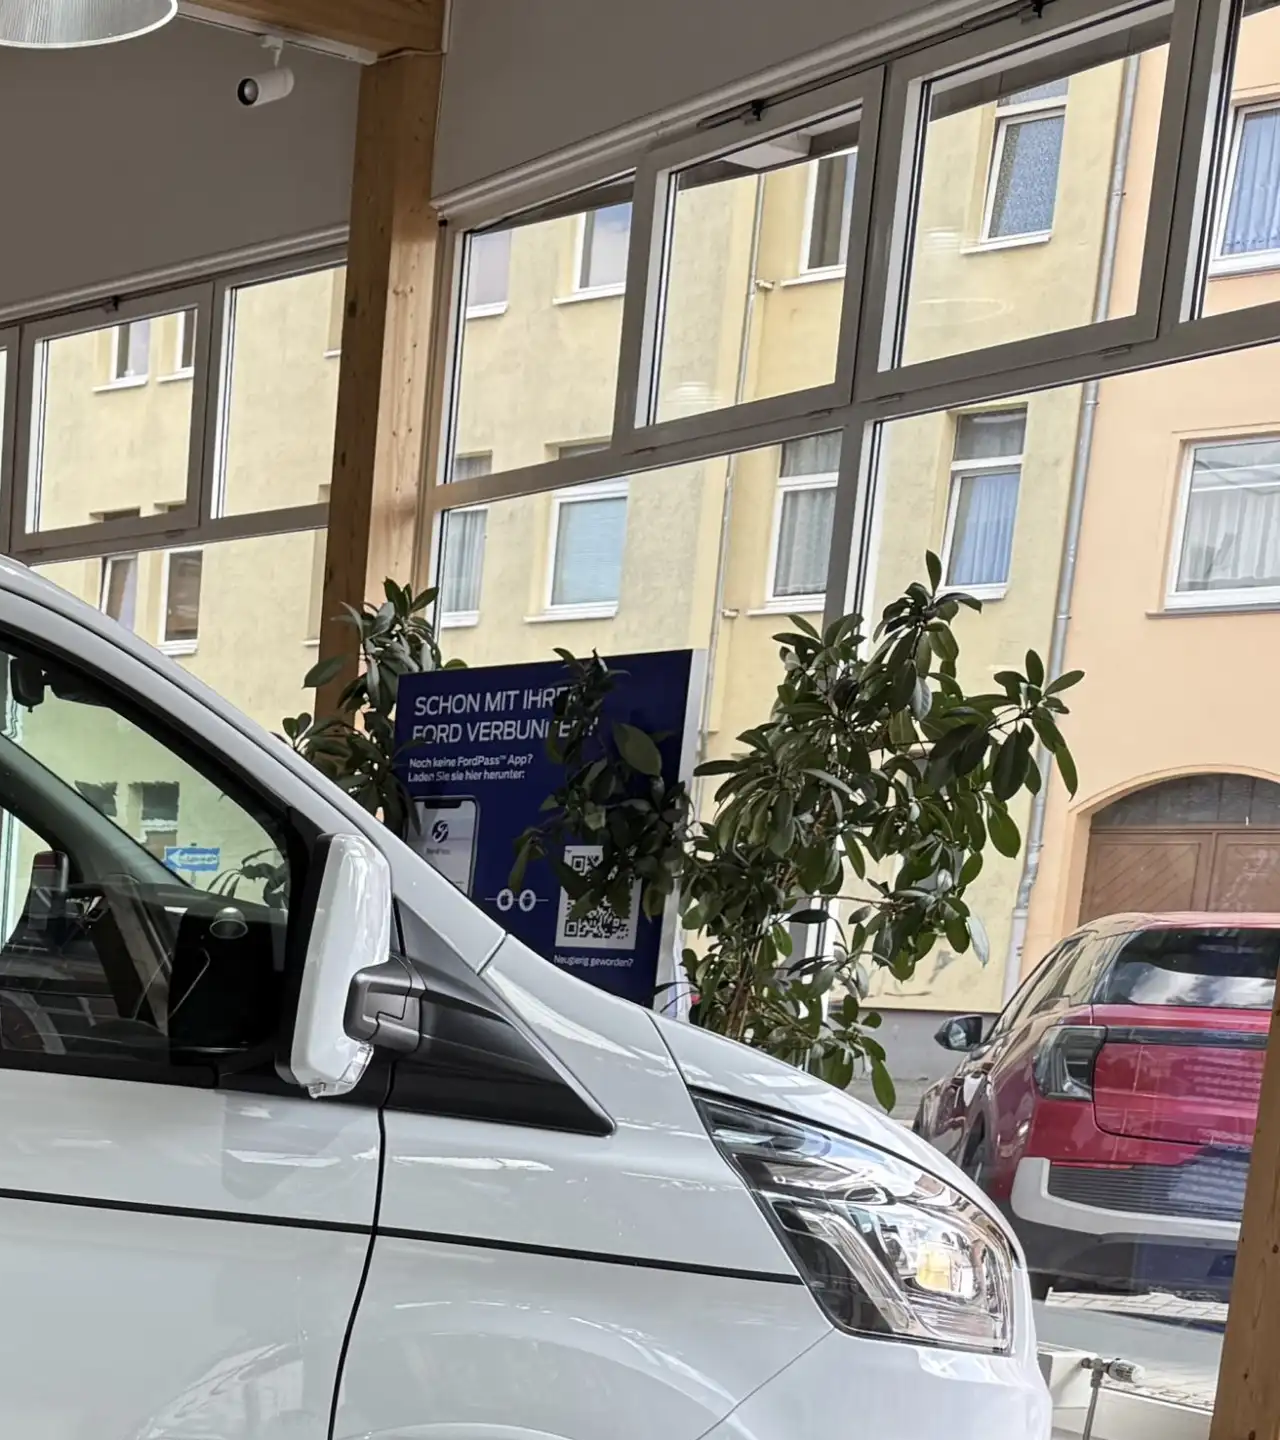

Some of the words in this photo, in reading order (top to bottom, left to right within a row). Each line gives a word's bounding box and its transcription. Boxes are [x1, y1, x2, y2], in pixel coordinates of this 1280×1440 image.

[414, 693, 481, 716] SCHON
[484, 690, 519, 713] MIT
[412, 722, 462, 745] FORD
[409, 757, 432, 768] Noch
[433, 756, 456, 768] keine
[507, 753, 534, 767] App?
[408, 771, 435, 782] Laden
[436, 770, 450, 781] Sie
[451, 769, 464, 781] sie
[465, 769, 483, 780] hier
